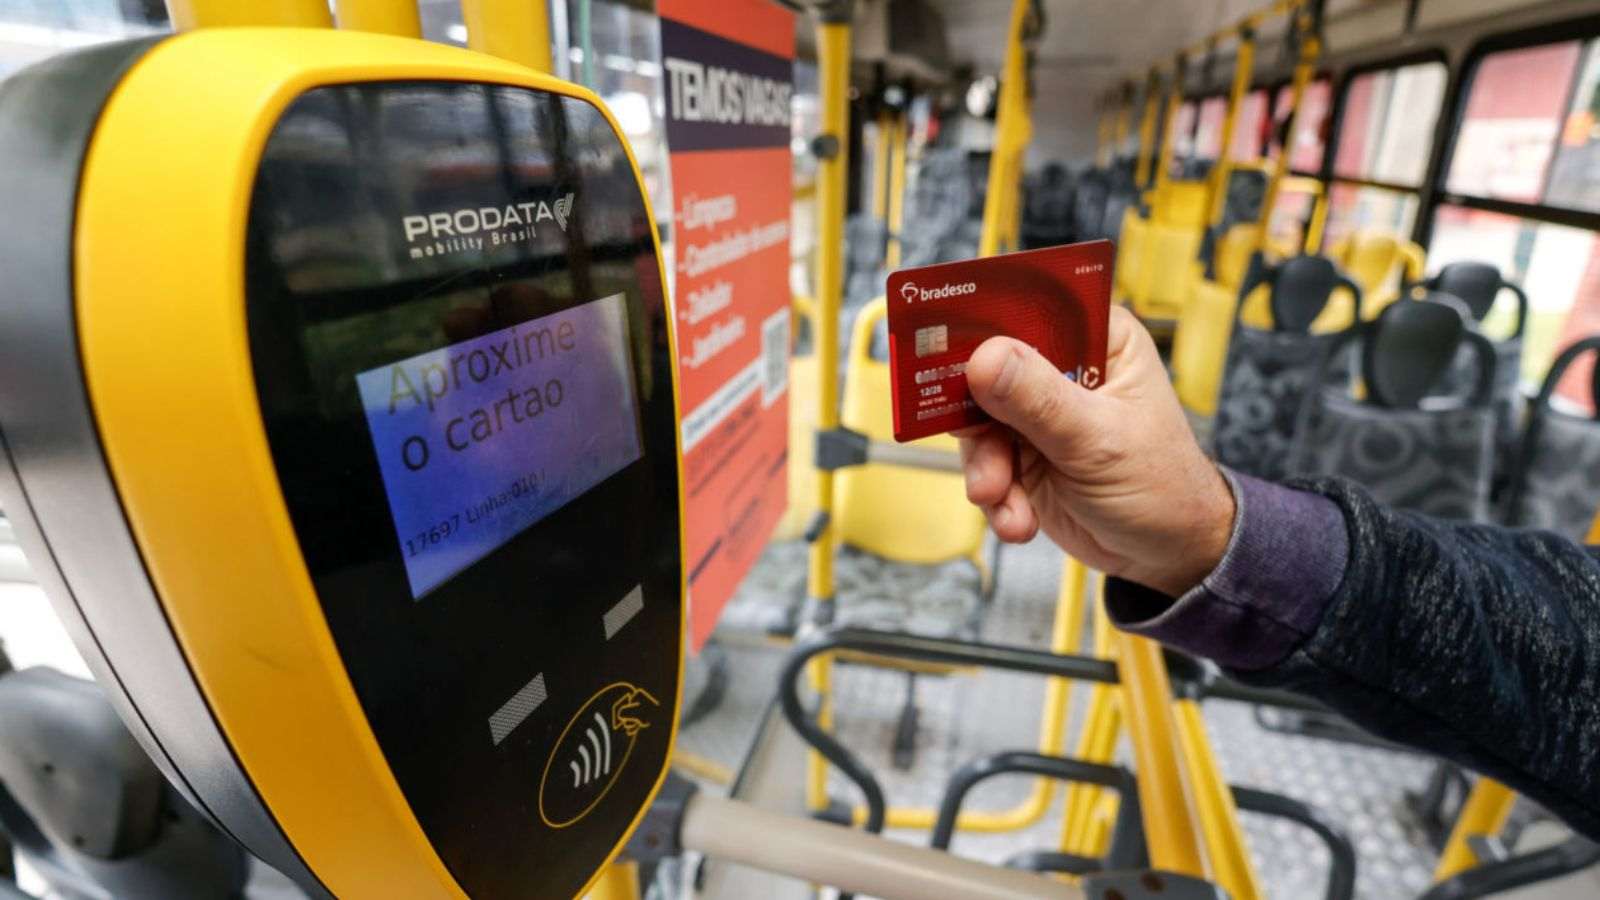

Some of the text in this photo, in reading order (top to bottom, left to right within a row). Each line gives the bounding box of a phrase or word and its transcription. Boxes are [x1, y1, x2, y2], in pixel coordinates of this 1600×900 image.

[665, 57, 742, 124] TEMOS
[403, 200, 553, 242] PRODATA
[409, 226, 537, 259] mobility Brasil
[920, 282, 977, 302] bradesco
[388, 319, 577, 415] Aproxime
[402, 378, 563, 472] o cartao
[406, 514, 460, 557] 17697
